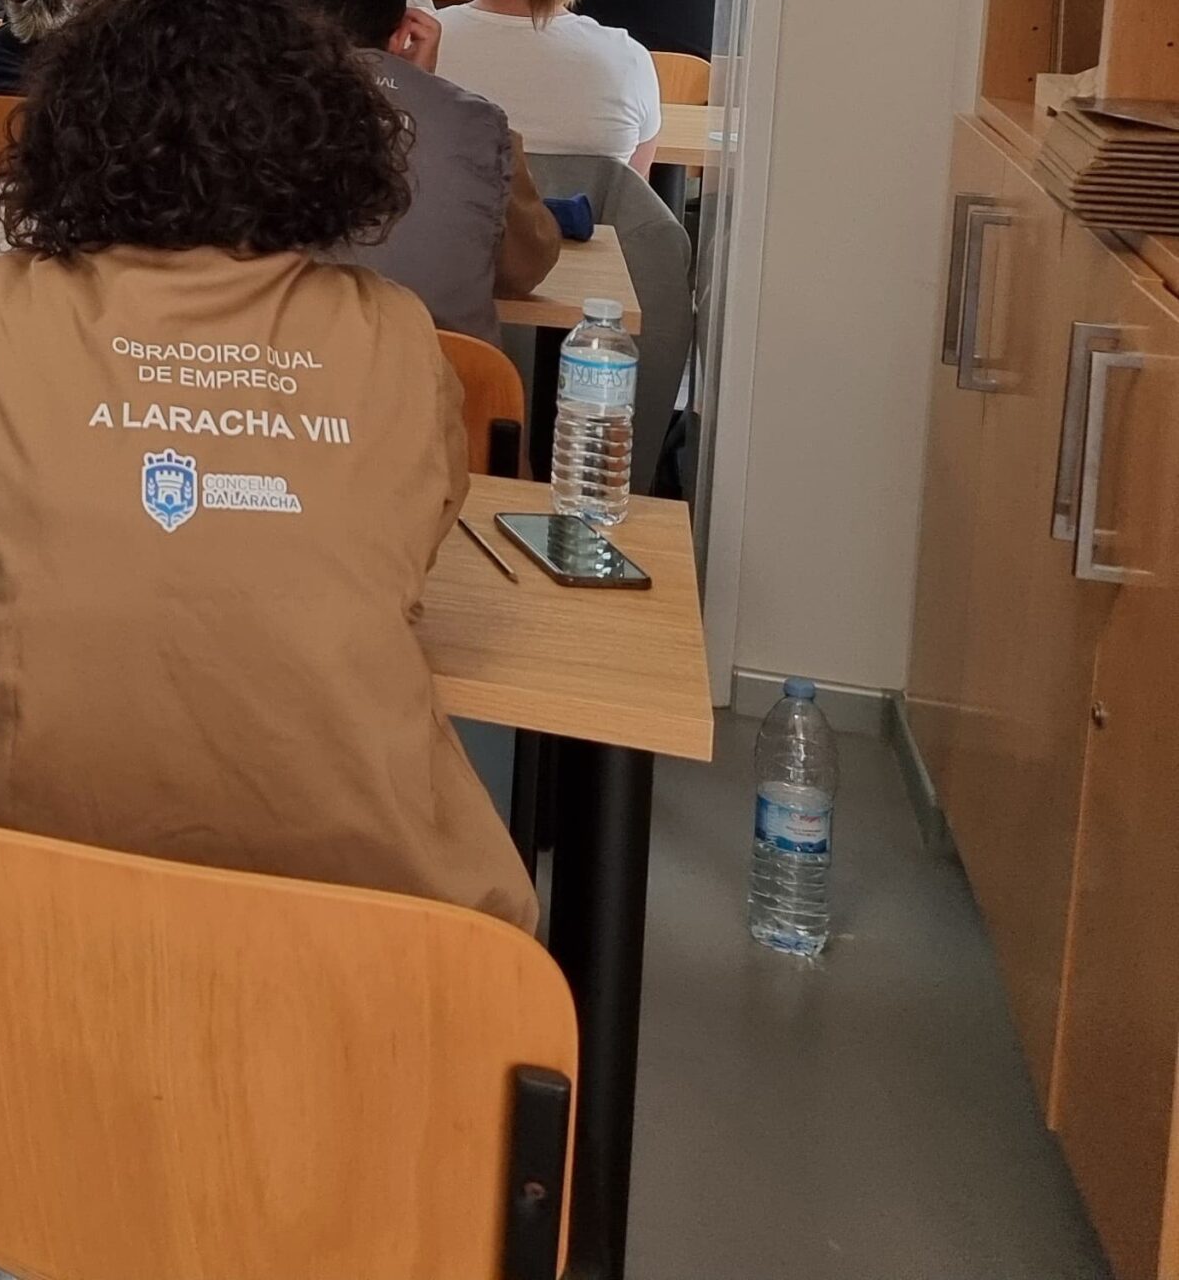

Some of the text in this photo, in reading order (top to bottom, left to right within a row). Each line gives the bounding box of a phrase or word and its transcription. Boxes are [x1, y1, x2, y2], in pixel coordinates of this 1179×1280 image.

[112, 336, 323, 369] OBRADOIRO DUAL
[138, 365, 297, 394] DE EMPREGO
[88, 402, 351, 444] A LARACHA VIII
[205, 476, 285, 491] CONCELLO
[205, 492, 299, 509] DA LARACHA
